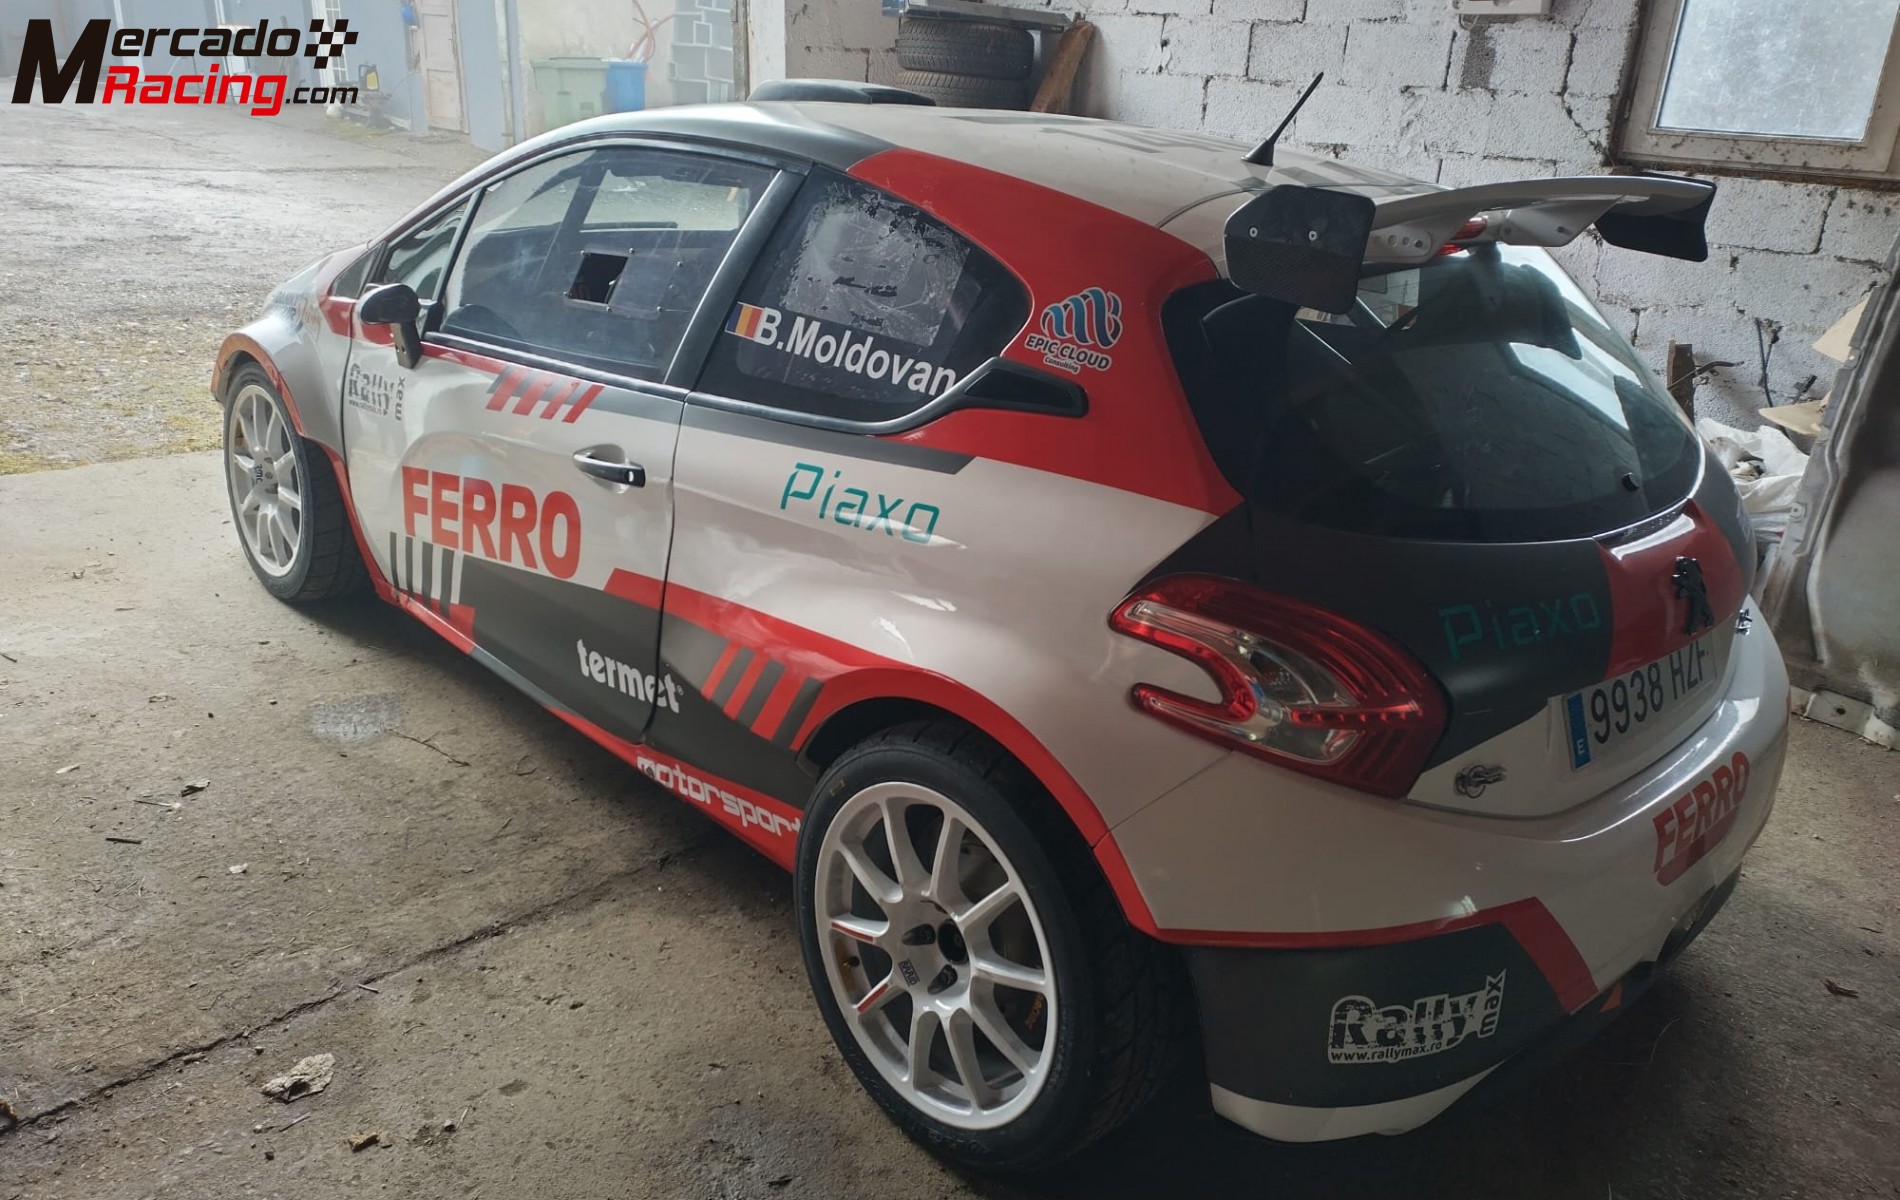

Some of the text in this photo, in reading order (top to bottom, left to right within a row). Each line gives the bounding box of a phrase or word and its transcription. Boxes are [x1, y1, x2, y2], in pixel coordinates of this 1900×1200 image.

[755, 307, 956, 396] B.Moldovan
[1026, 335, 1110, 370] EPIC CLOUD
[1044, 356, 1079, 373] Consulting
[348, 363, 394, 416] Rally
[395, 376, 405, 421] max
[402, 466, 582, 579] FERRO
[781, 462, 940, 544] Piaxo
[1438, 591, 1601, 660] Piaxo
[1591, 662, 1663, 744] 9938
[1577, 739, 1583, 755] E
[1652, 751, 1750, 874] FERRO
[1331, 996, 1478, 1048] Rally
[1479, 981, 1502, 1035] max
[1331, 1041, 1443, 1061] www.rallymax.ro
